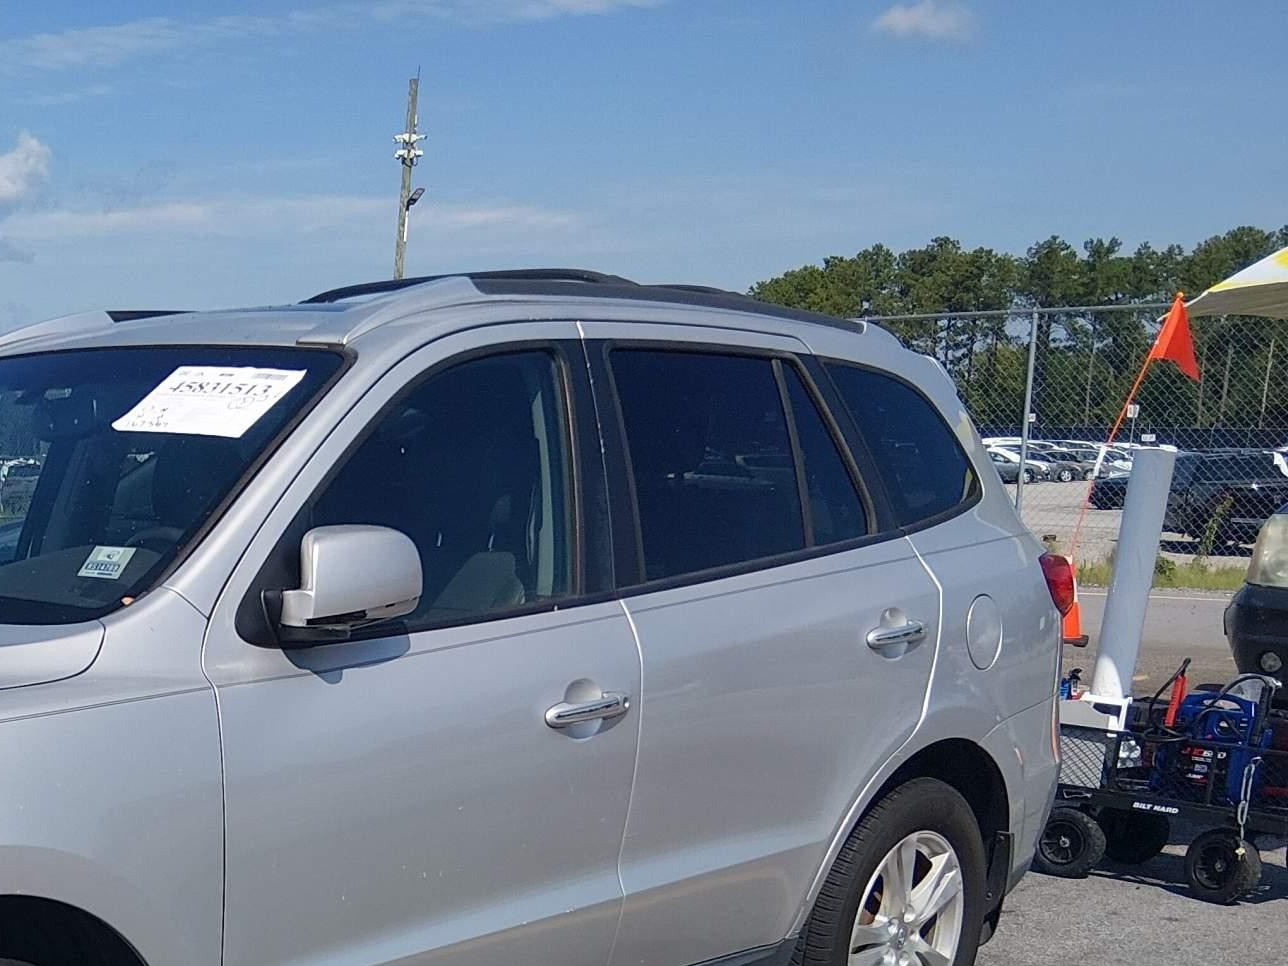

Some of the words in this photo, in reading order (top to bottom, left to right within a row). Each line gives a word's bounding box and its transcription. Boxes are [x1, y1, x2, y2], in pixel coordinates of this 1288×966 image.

[169, 380, 273, 396] 45831513
[1132, 801, 1153, 810] BILT
[1153, 805, 1179, 814] HARD
